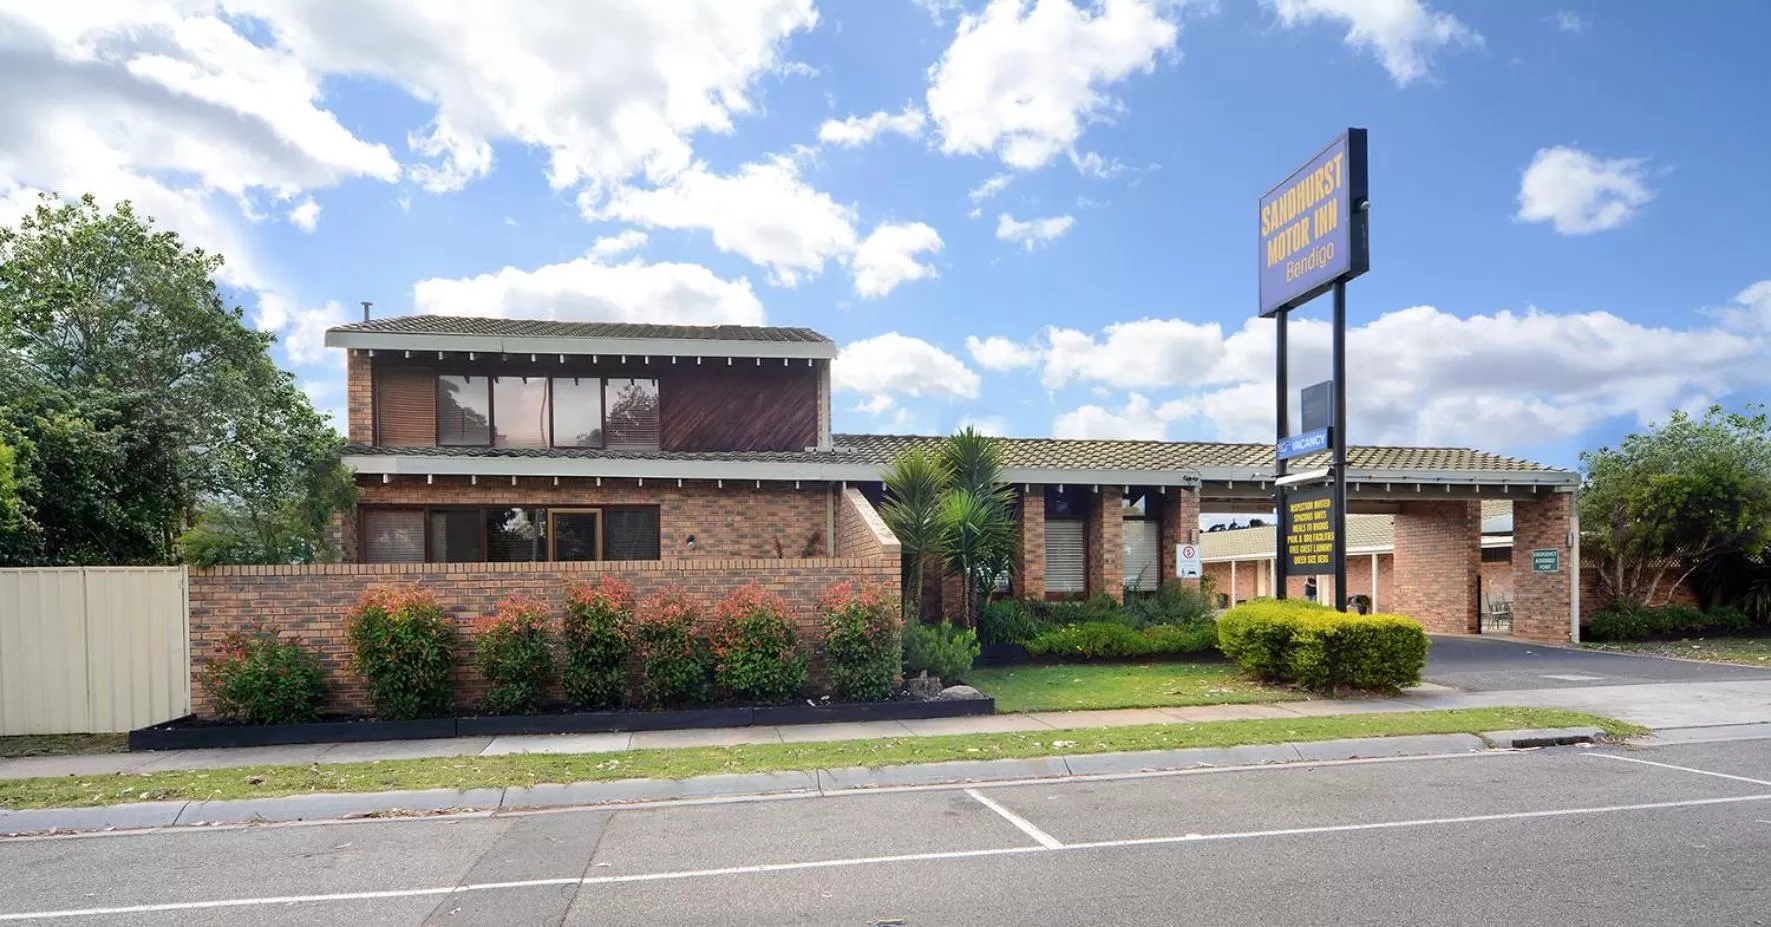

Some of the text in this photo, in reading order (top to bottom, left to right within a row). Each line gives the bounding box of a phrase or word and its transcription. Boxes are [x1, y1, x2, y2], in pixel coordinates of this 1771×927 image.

[1261, 152, 1343, 237] SANDHURST
[1267, 198, 1338, 267] MOTOR INN
[1286, 241, 1335, 282] Bendigo
[1292, 433, 1326, 450] VACANCY
